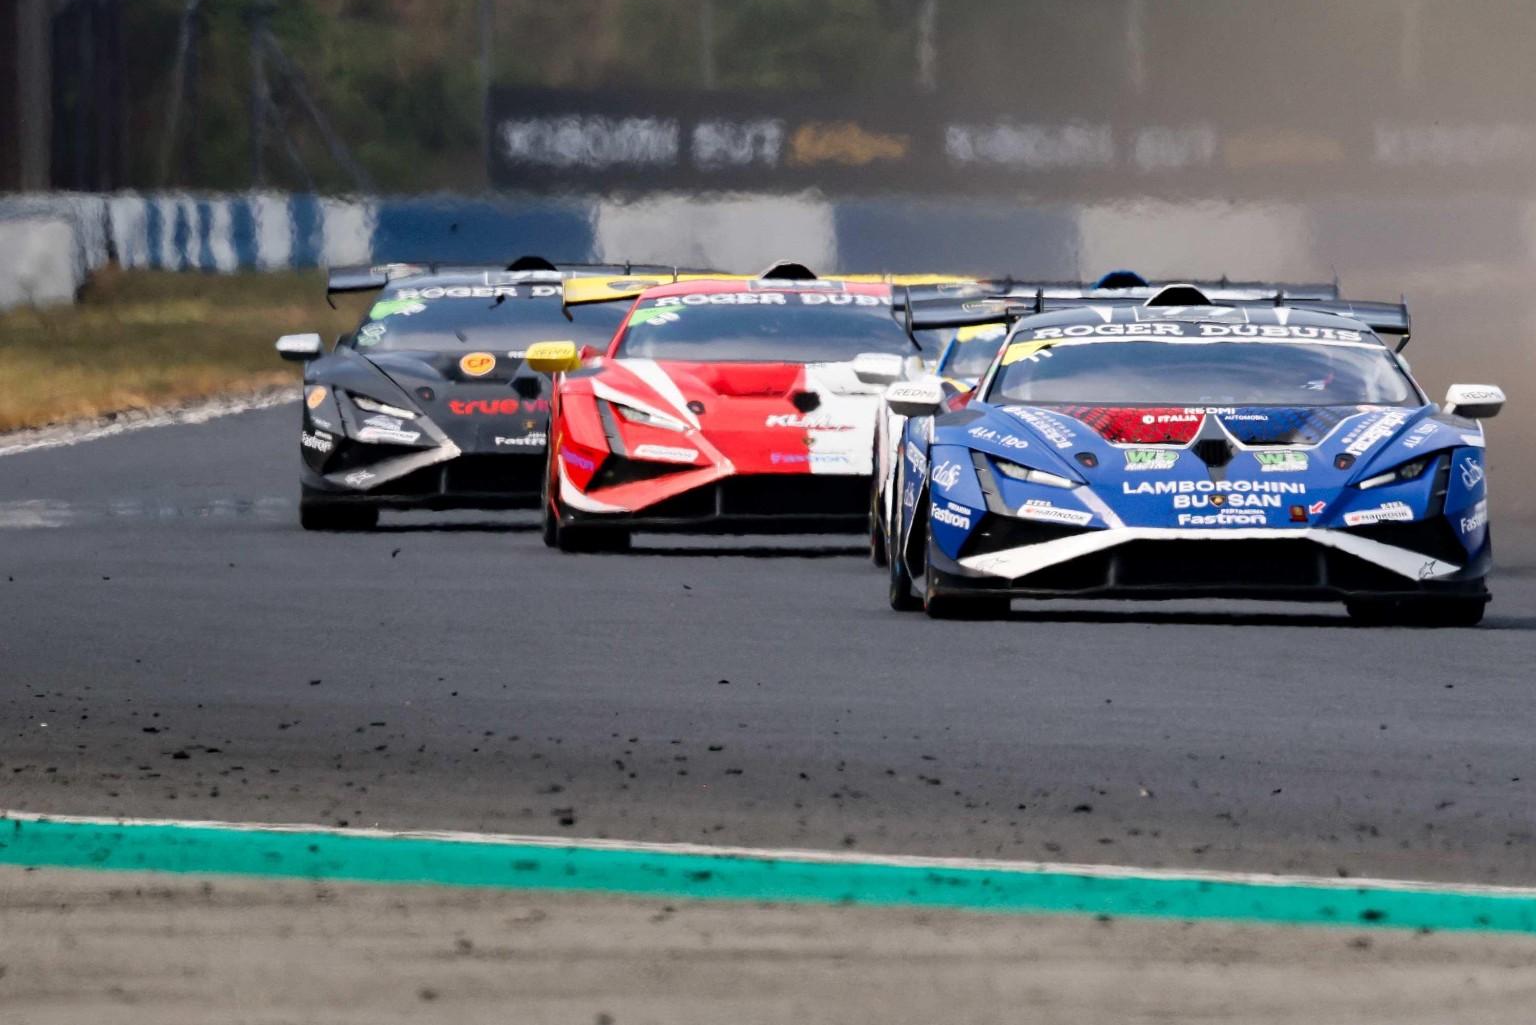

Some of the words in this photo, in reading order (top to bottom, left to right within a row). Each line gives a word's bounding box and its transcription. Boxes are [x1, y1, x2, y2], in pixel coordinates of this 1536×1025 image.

[655, 293, 786, 306] ROGER
[1032, 323, 1186, 340] ROGER
[1199, 324, 1363, 343] DUBUIS
[448, 398, 519, 414] true
[1184, 407, 1236, 415] REDMI
[1157, 414, 1199, 423] ITALIA
[1122, 480, 1307, 495] LAMBORGHINI
[1177, 513, 1268, 526] Fastron
